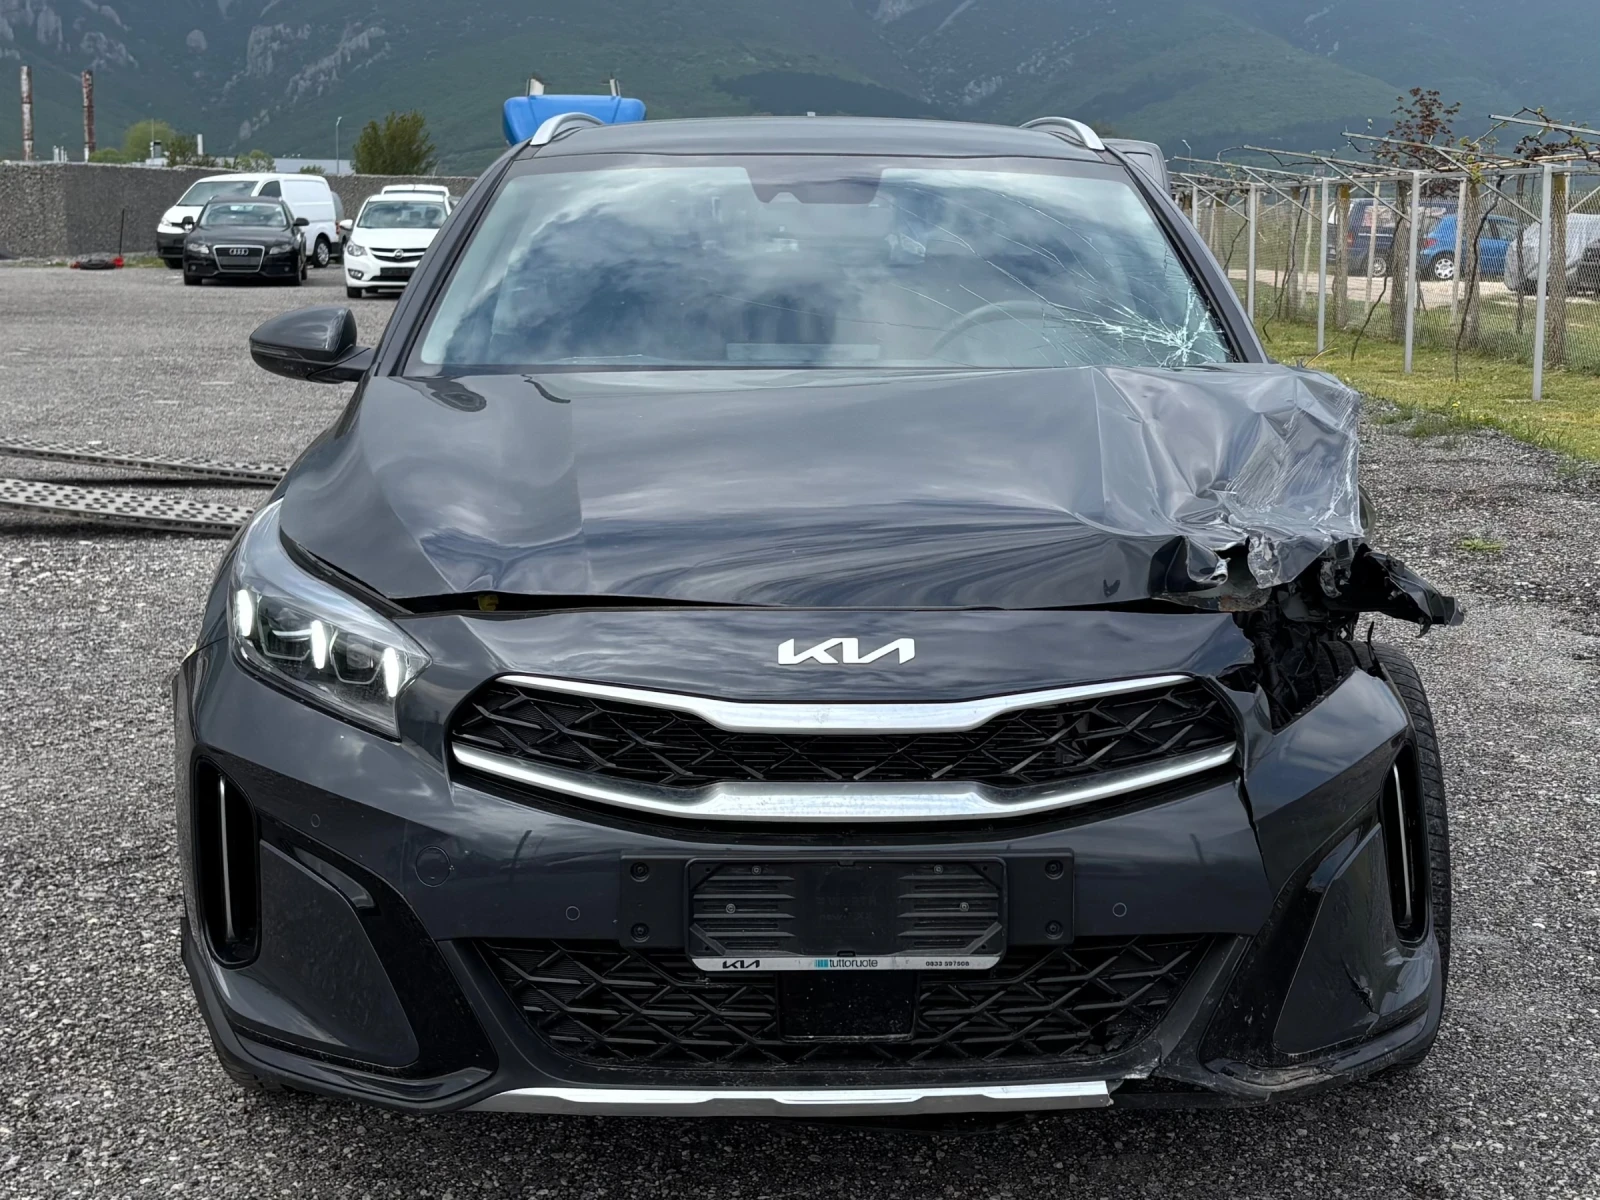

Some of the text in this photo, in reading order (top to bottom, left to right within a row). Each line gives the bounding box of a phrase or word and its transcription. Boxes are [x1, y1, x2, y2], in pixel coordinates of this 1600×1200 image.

[778, 637, 915, 665] KIA
[722, 960, 760, 970] KIA
[829, 959, 878, 968] tuttoruote
